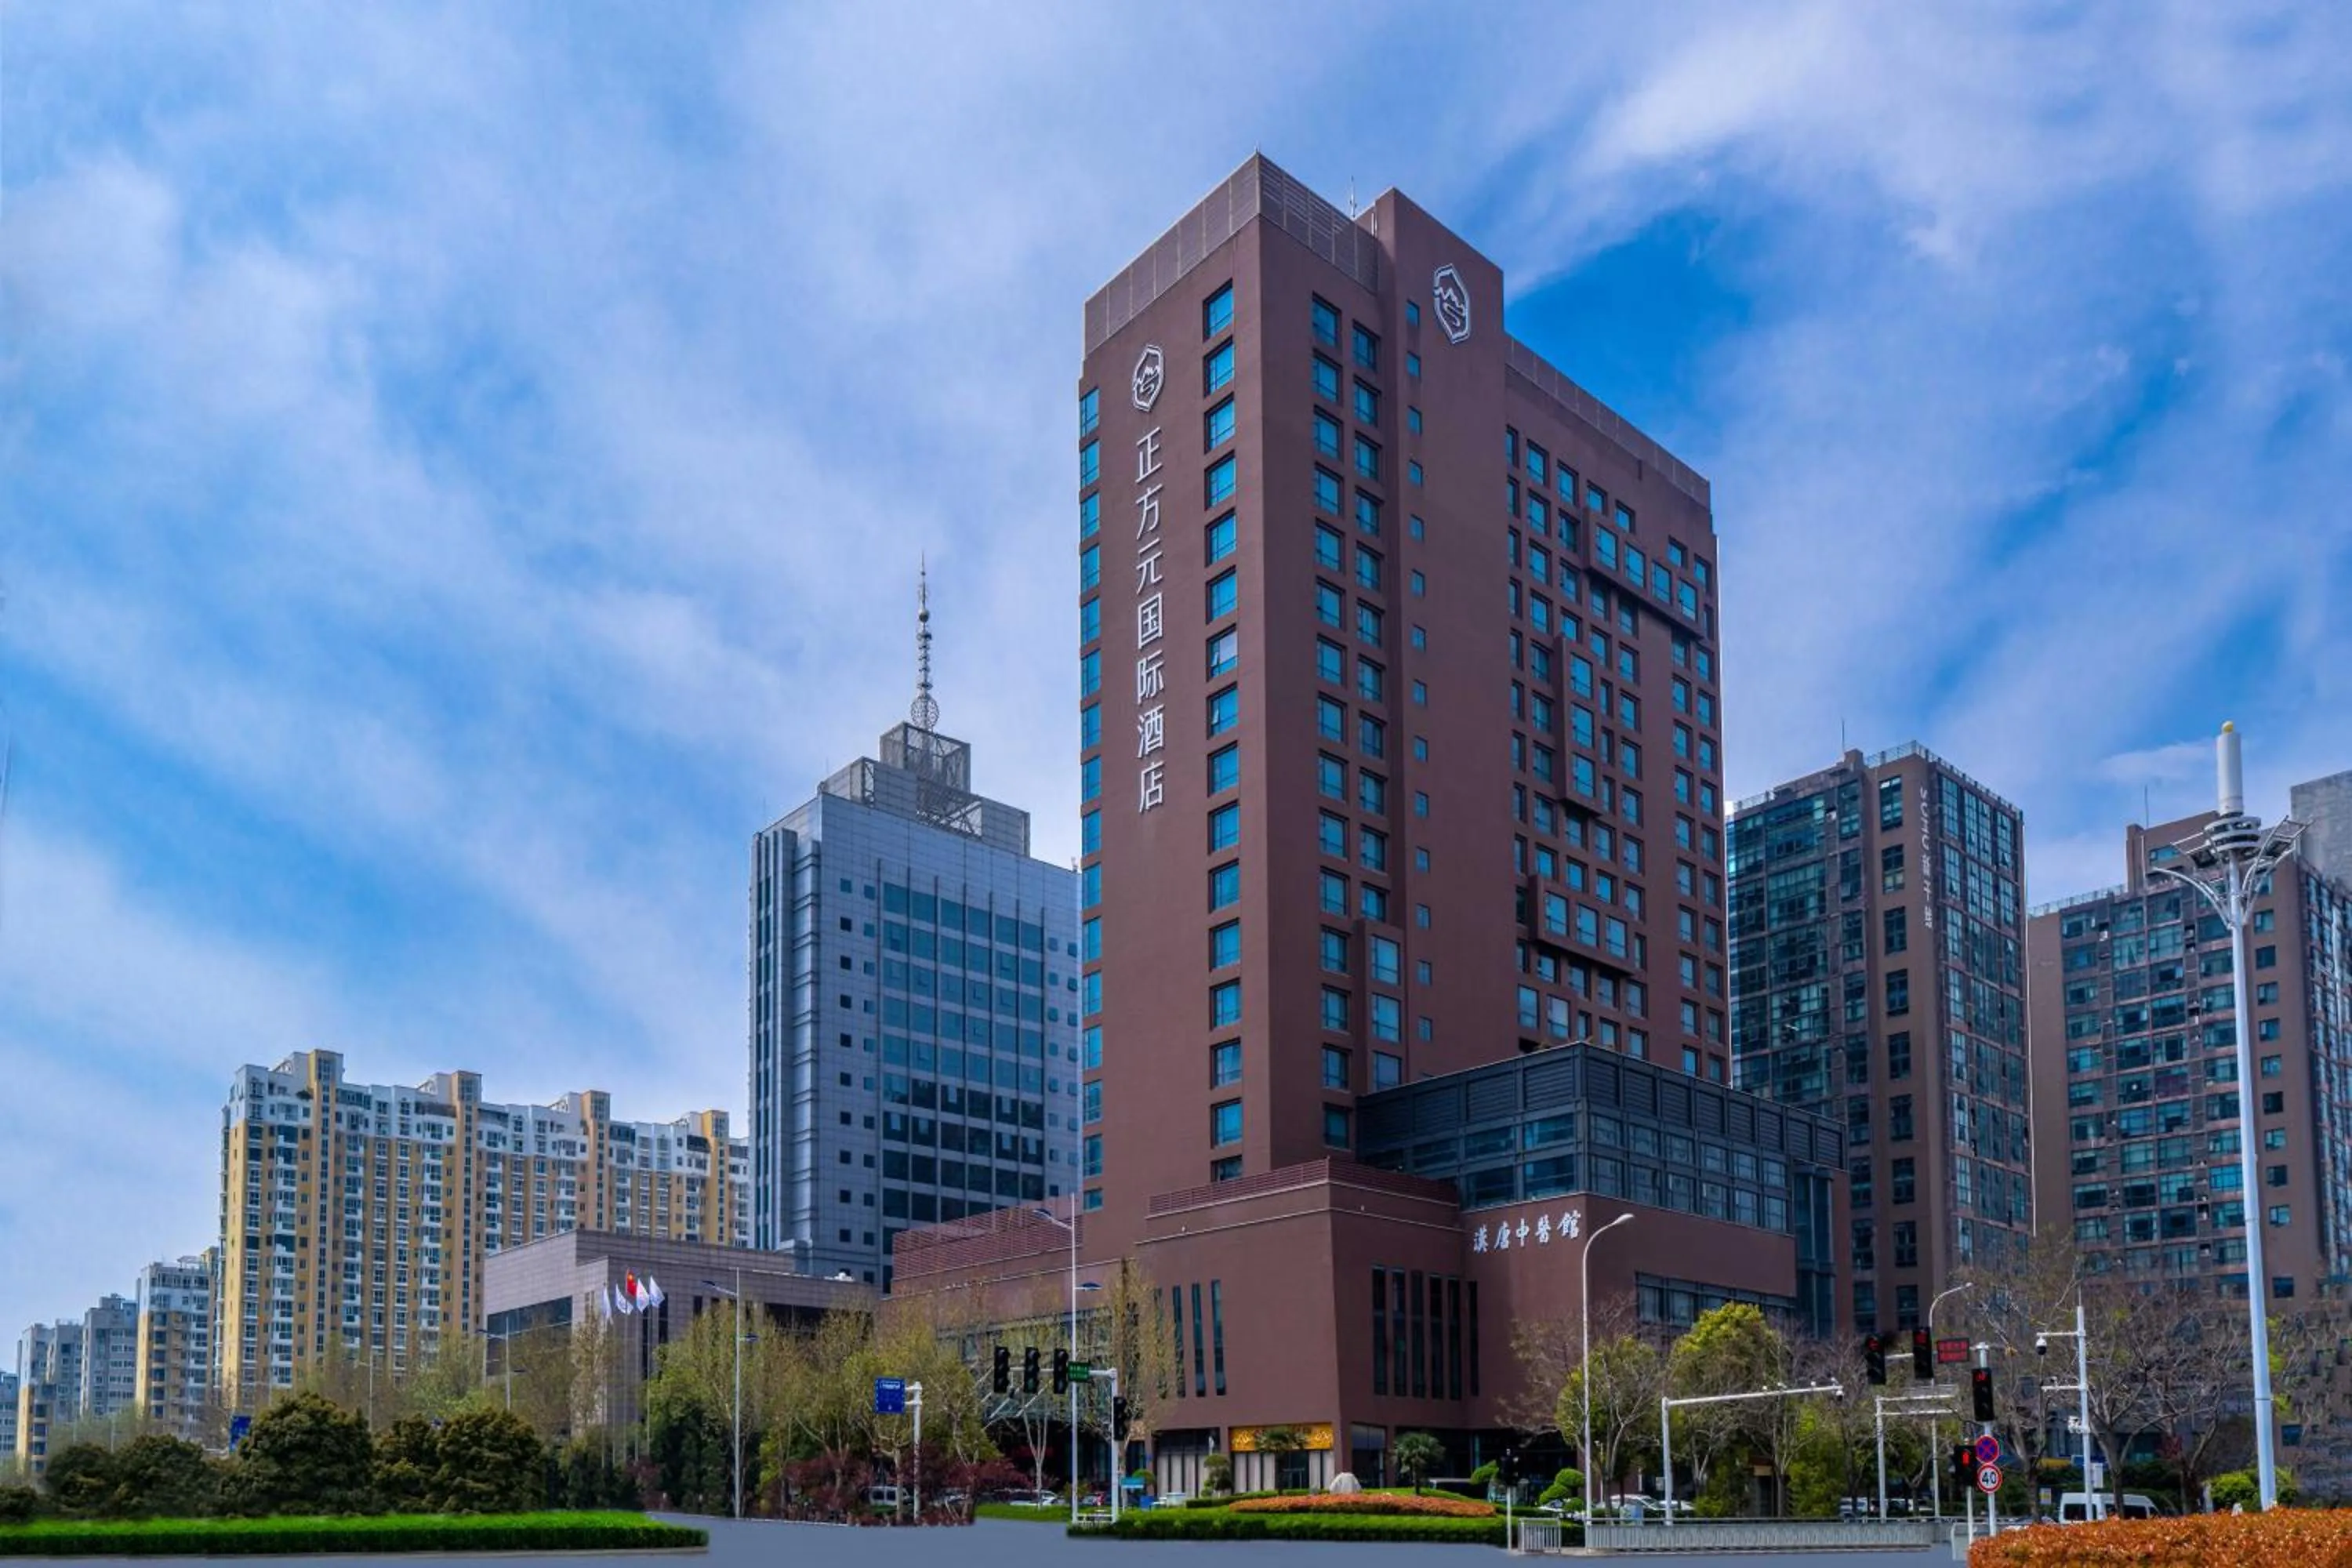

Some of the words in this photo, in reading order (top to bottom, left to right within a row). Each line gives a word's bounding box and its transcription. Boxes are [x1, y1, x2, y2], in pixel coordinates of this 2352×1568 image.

[1136, 426, 1163, 812] 正方元国际酒店
[1982, 1472, 1996, 1486] 40
